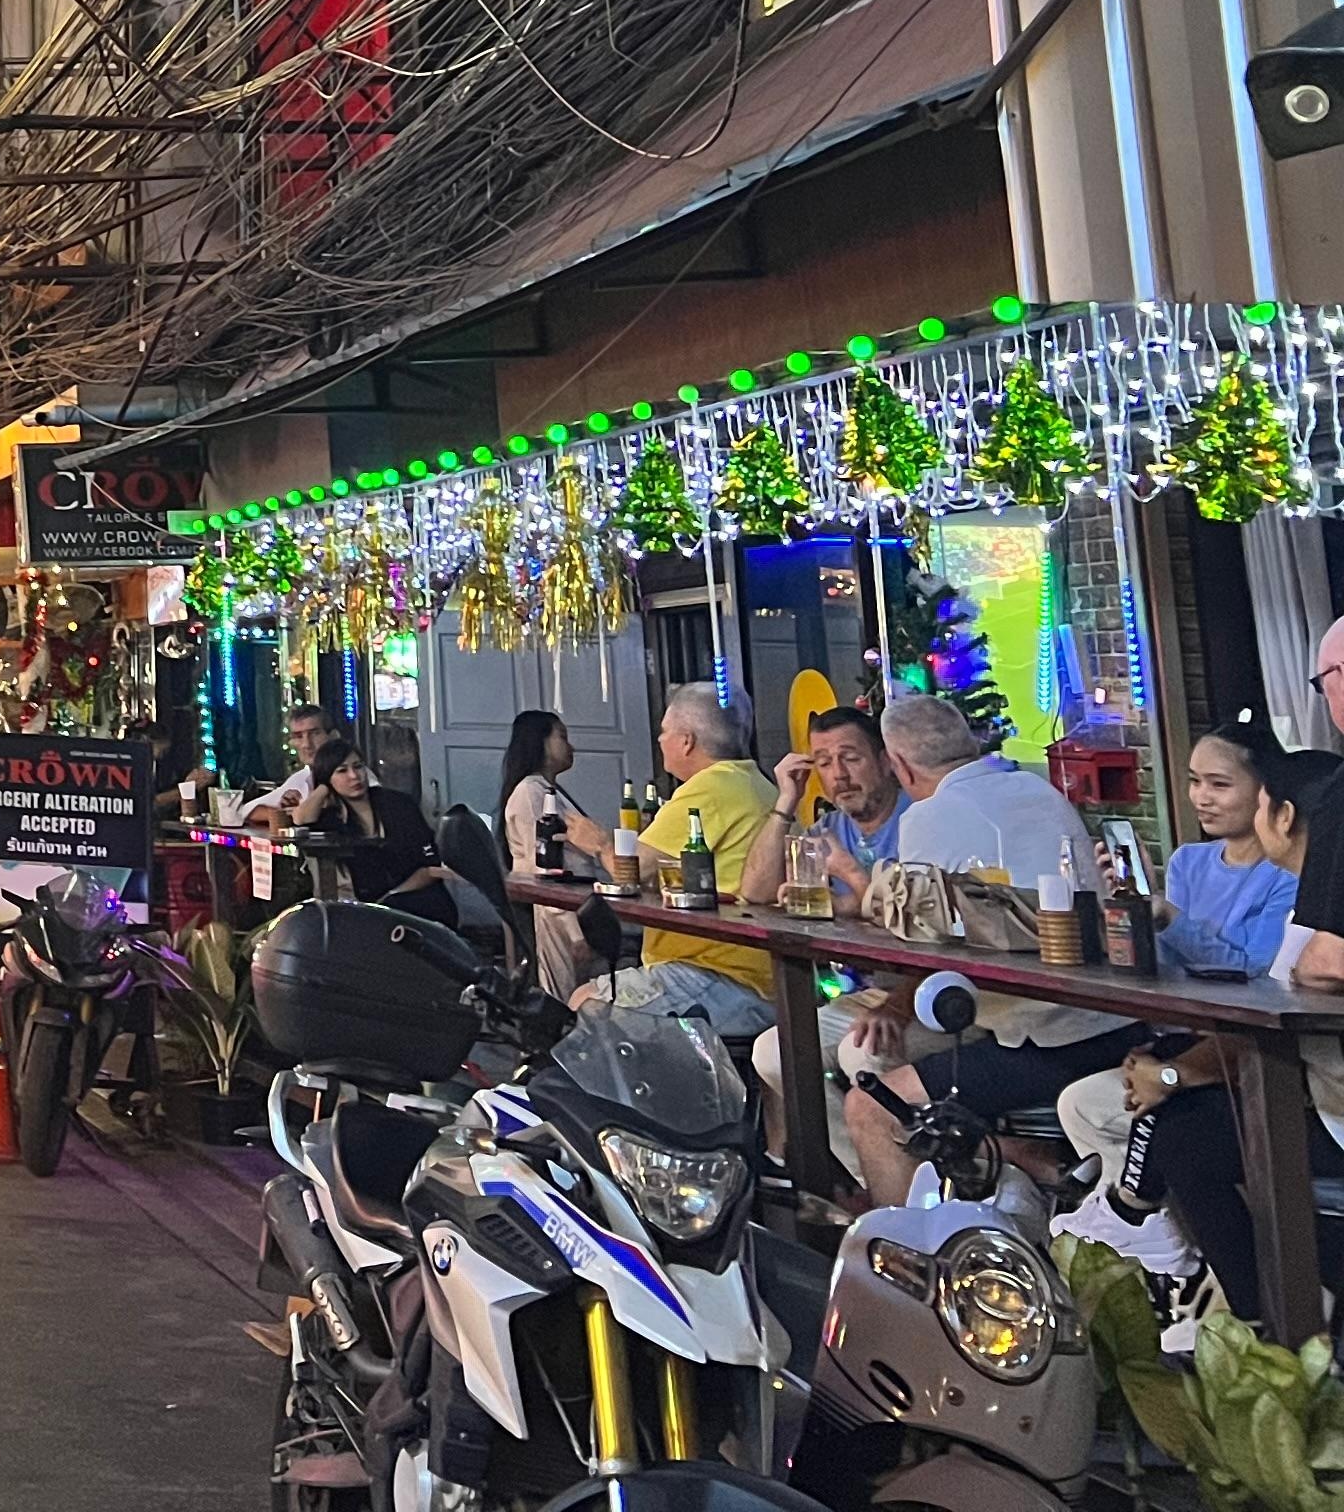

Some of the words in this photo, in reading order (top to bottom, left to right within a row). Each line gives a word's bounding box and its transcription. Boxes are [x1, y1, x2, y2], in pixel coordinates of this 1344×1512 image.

[44, 792, 135, 816] ALTERATION
[20, 814, 97, 836] ACCEPTED
[542, 1212, 600, 1271] BMW
